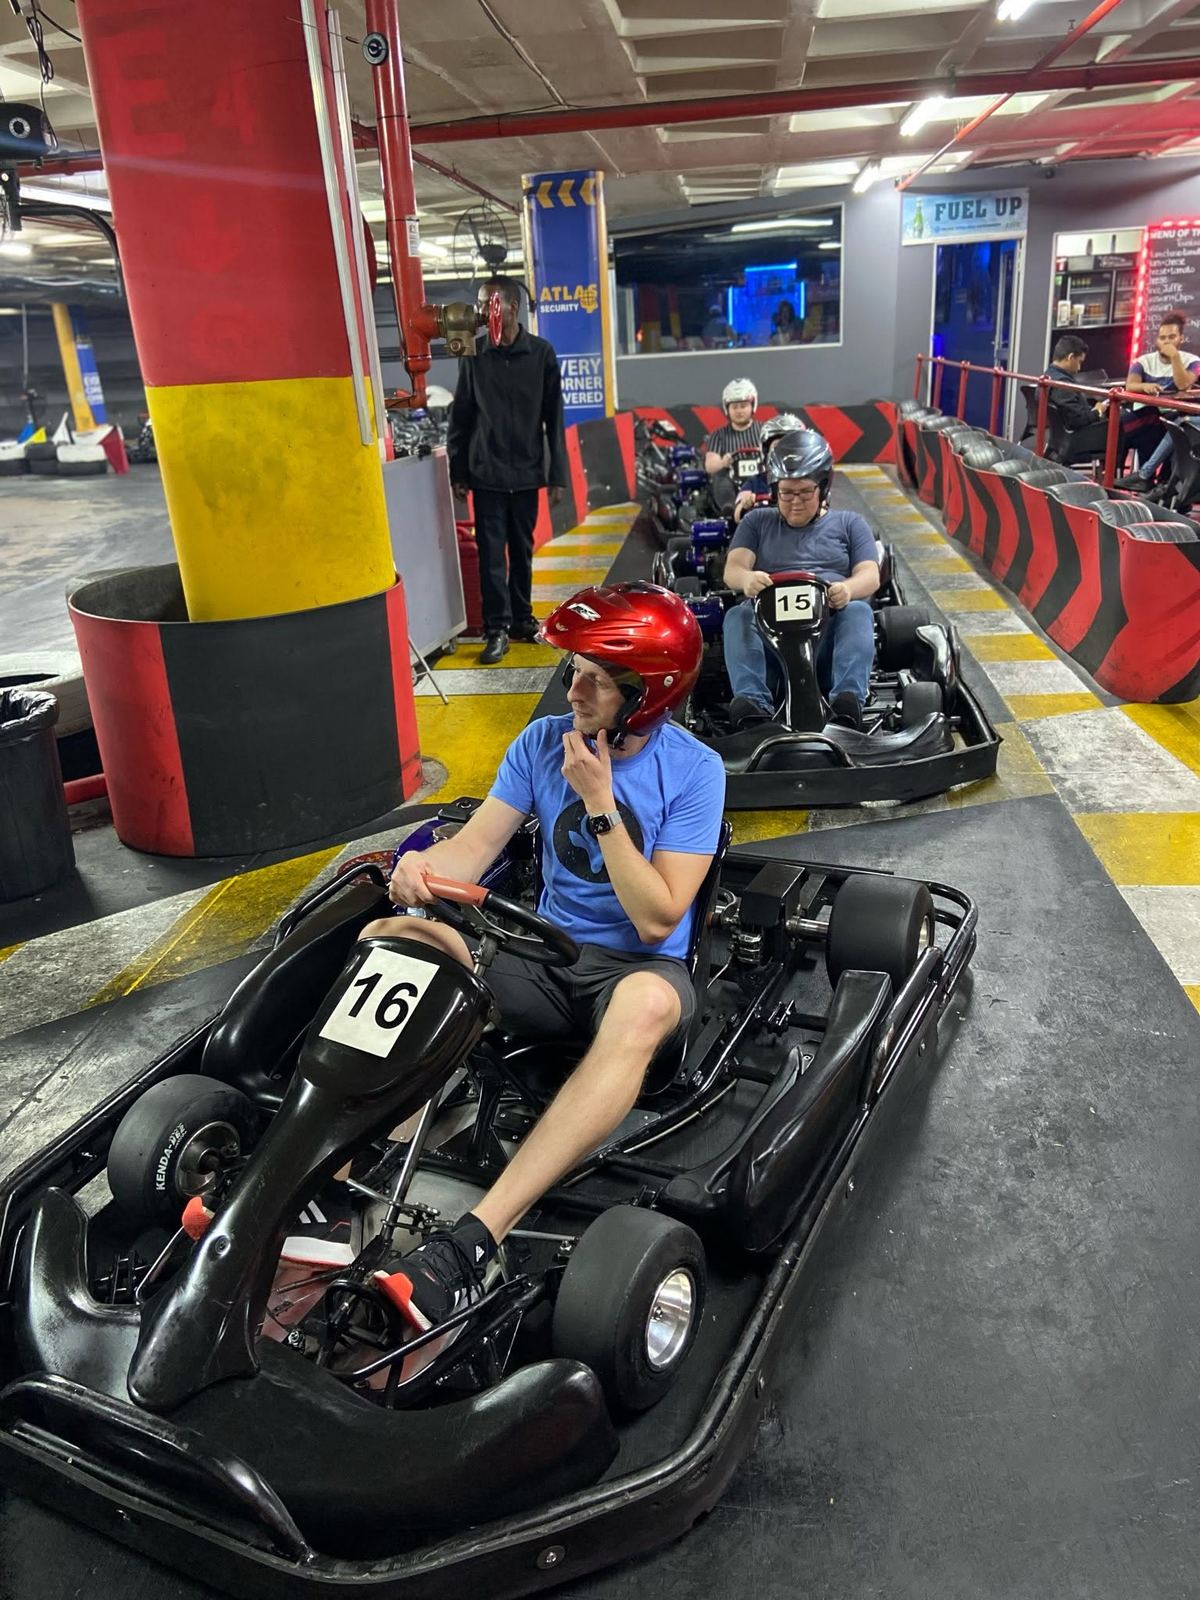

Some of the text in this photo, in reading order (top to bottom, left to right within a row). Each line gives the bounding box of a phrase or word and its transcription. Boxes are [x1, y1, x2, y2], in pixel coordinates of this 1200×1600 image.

[935, 196, 1023, 222] FUEL UP
[1177, 228, 1190, 238] OF
[540, 284, 598, 302] ATLAS
[540, 303, 579, 313] SECURITY
[560, 358, 602, 376] VERY
[561, 376, 603, 391] RNER
[562, 391, 604, 405] VERED
[741, 463, 756, 473] 10
[777, 594, 811, 612] 15
[348, 972, 418, 1029] 16
